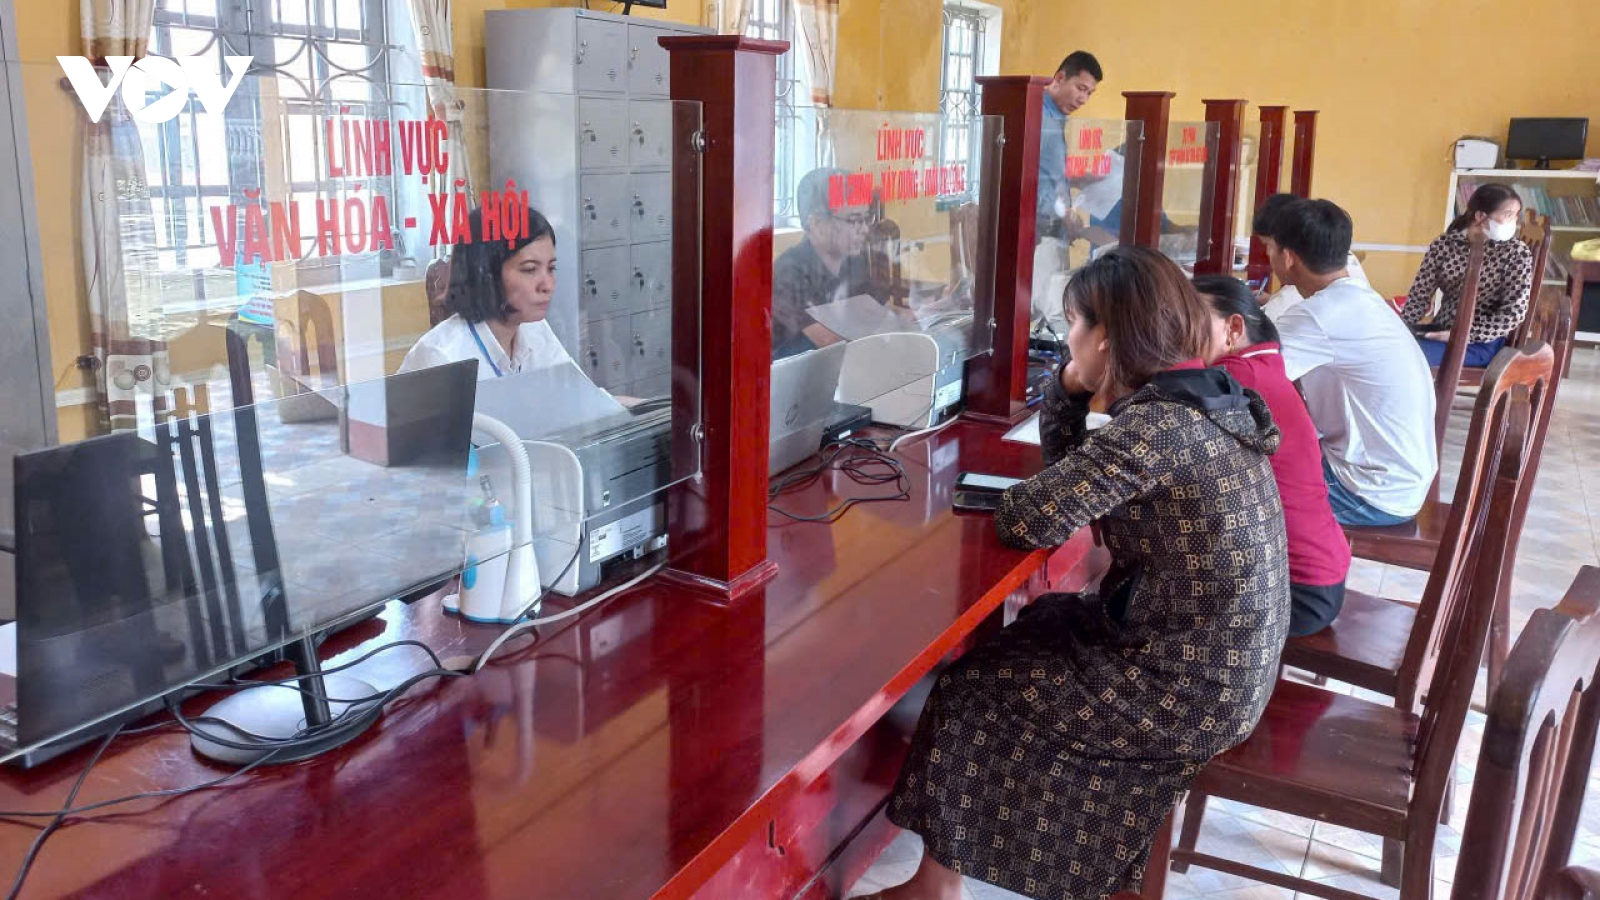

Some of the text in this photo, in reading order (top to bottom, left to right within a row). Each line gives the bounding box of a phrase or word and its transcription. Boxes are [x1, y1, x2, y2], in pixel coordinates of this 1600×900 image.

[326, 106, 449, 184] LĨNH VỰC
[210, 187, 302, 267] VĂN
[316, 184, 394, 256] HÓA
[428, 180, 472, 246] XÃ
[481, 178, 530, 249] HỘI
